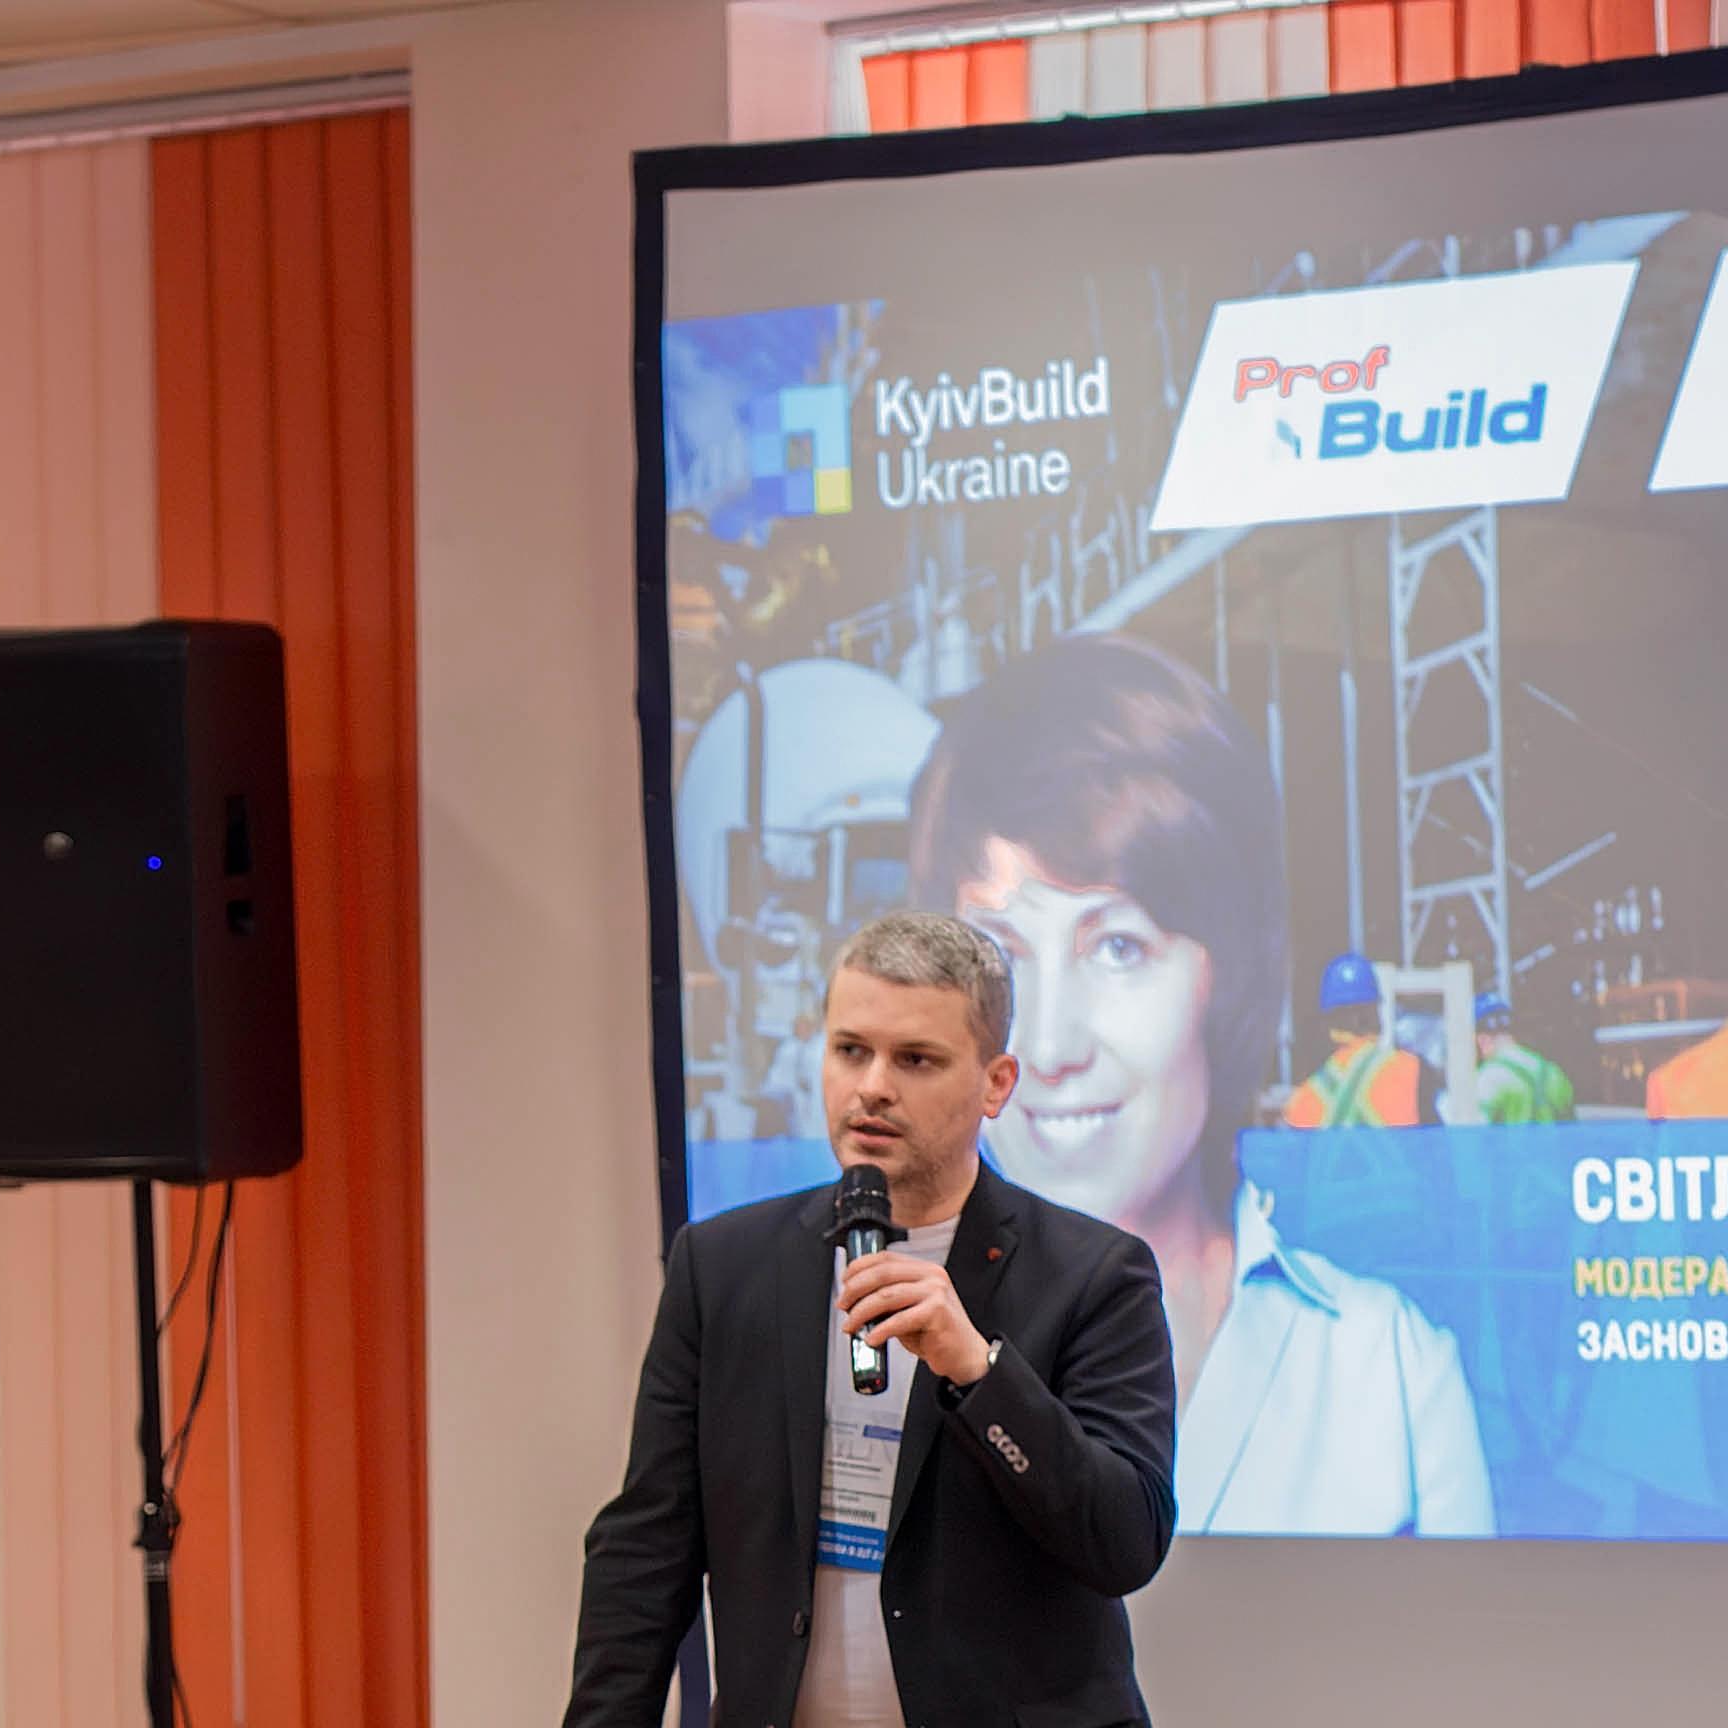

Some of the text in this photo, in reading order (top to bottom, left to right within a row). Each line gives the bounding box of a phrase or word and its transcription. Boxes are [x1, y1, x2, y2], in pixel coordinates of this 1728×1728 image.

[875, 354, 1110, 448] KyivBuild
[1233, 344, 1390, 403] Prof
[1318, 383, 1548, 460] Build
[876, 437, 1073, 510] Ukraine
